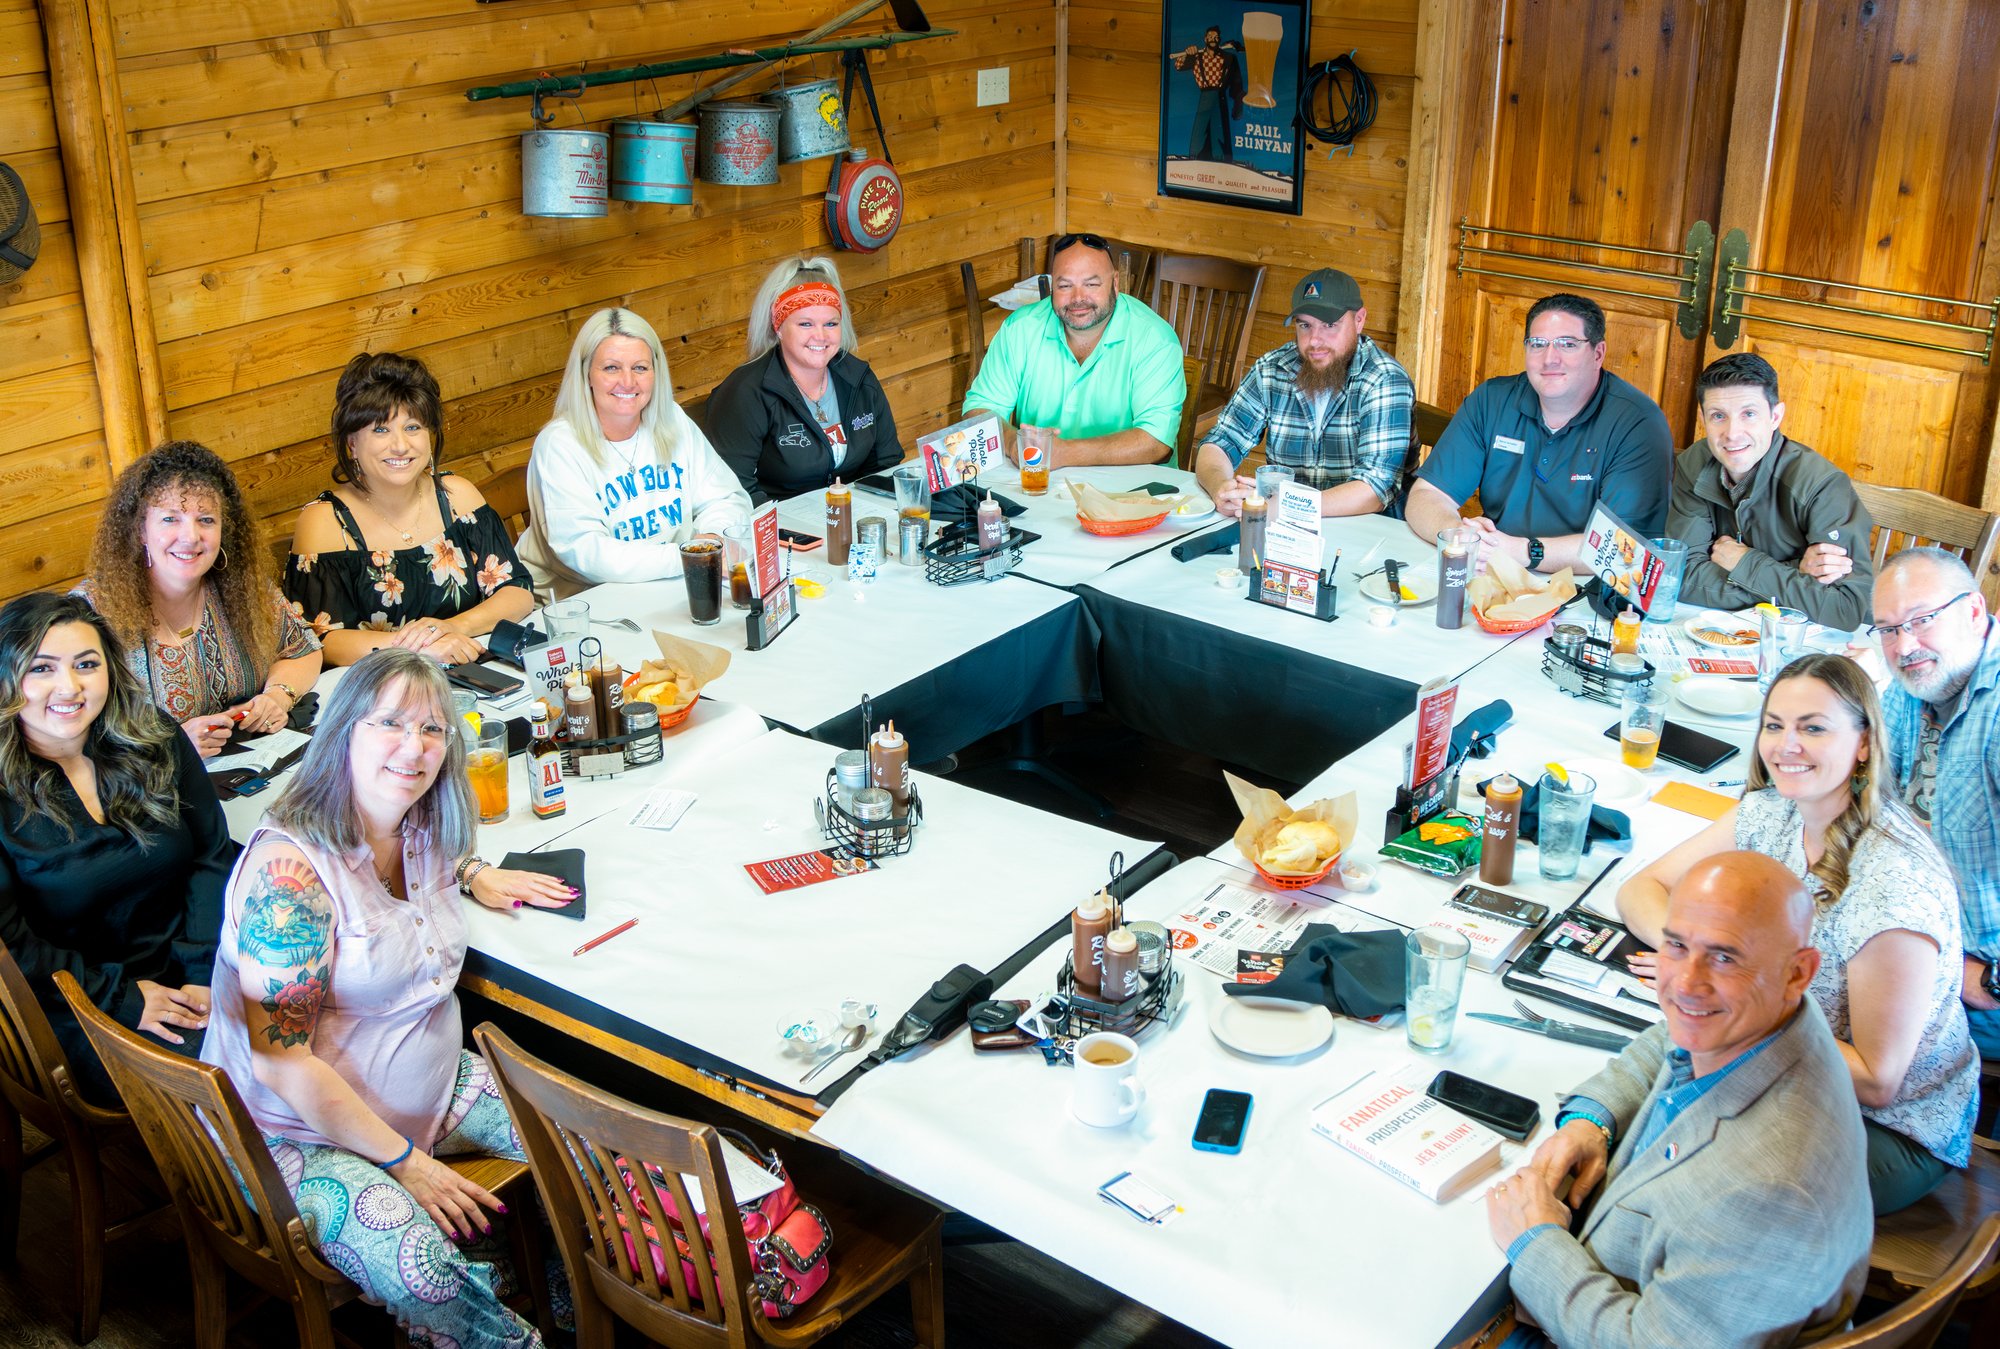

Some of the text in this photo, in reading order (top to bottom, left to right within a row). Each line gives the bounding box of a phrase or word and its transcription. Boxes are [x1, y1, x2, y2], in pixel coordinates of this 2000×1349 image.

[1246, 123, 1281, 139] PAUL
[1234, 136, 1292, 154] BUNYAN
[860, 180, 896, 209] PINE LAKE
[1170, 172, 1194, 182] HONESTLY
[1196, 173, 1216, 184] GREAT
[1225, 180, 1248, 189] QUALITY
[1262, 185, 1288, 194] PLEASURE
[868, 193, 888, 214] Resort
[968, 439, 977, 464] Pies
[976, 428, 988, 466] Whole
[1284, 492, 1312, 507] Catering
[613, 497, 683, 542] CREW
[1594, 529, 1613, 566] Whole
[1604, 542, 1619, 569] Pies
[547, 678, 565, 691] Pi
[1506, 812, 1512, 823] &
[1340, 1086, 1414, 1132] FANATICAL
[1366, 1097, 1438, 1145] PROSPECTING
[1415, 1147, 1437, 1166] JEB
[1434, 1123, 1474, 1155] BLOUNT
[1345, 1140, 1377, 1164] FANATICAL
[1379, 1160, 1420, 1189] PROSPECTING
